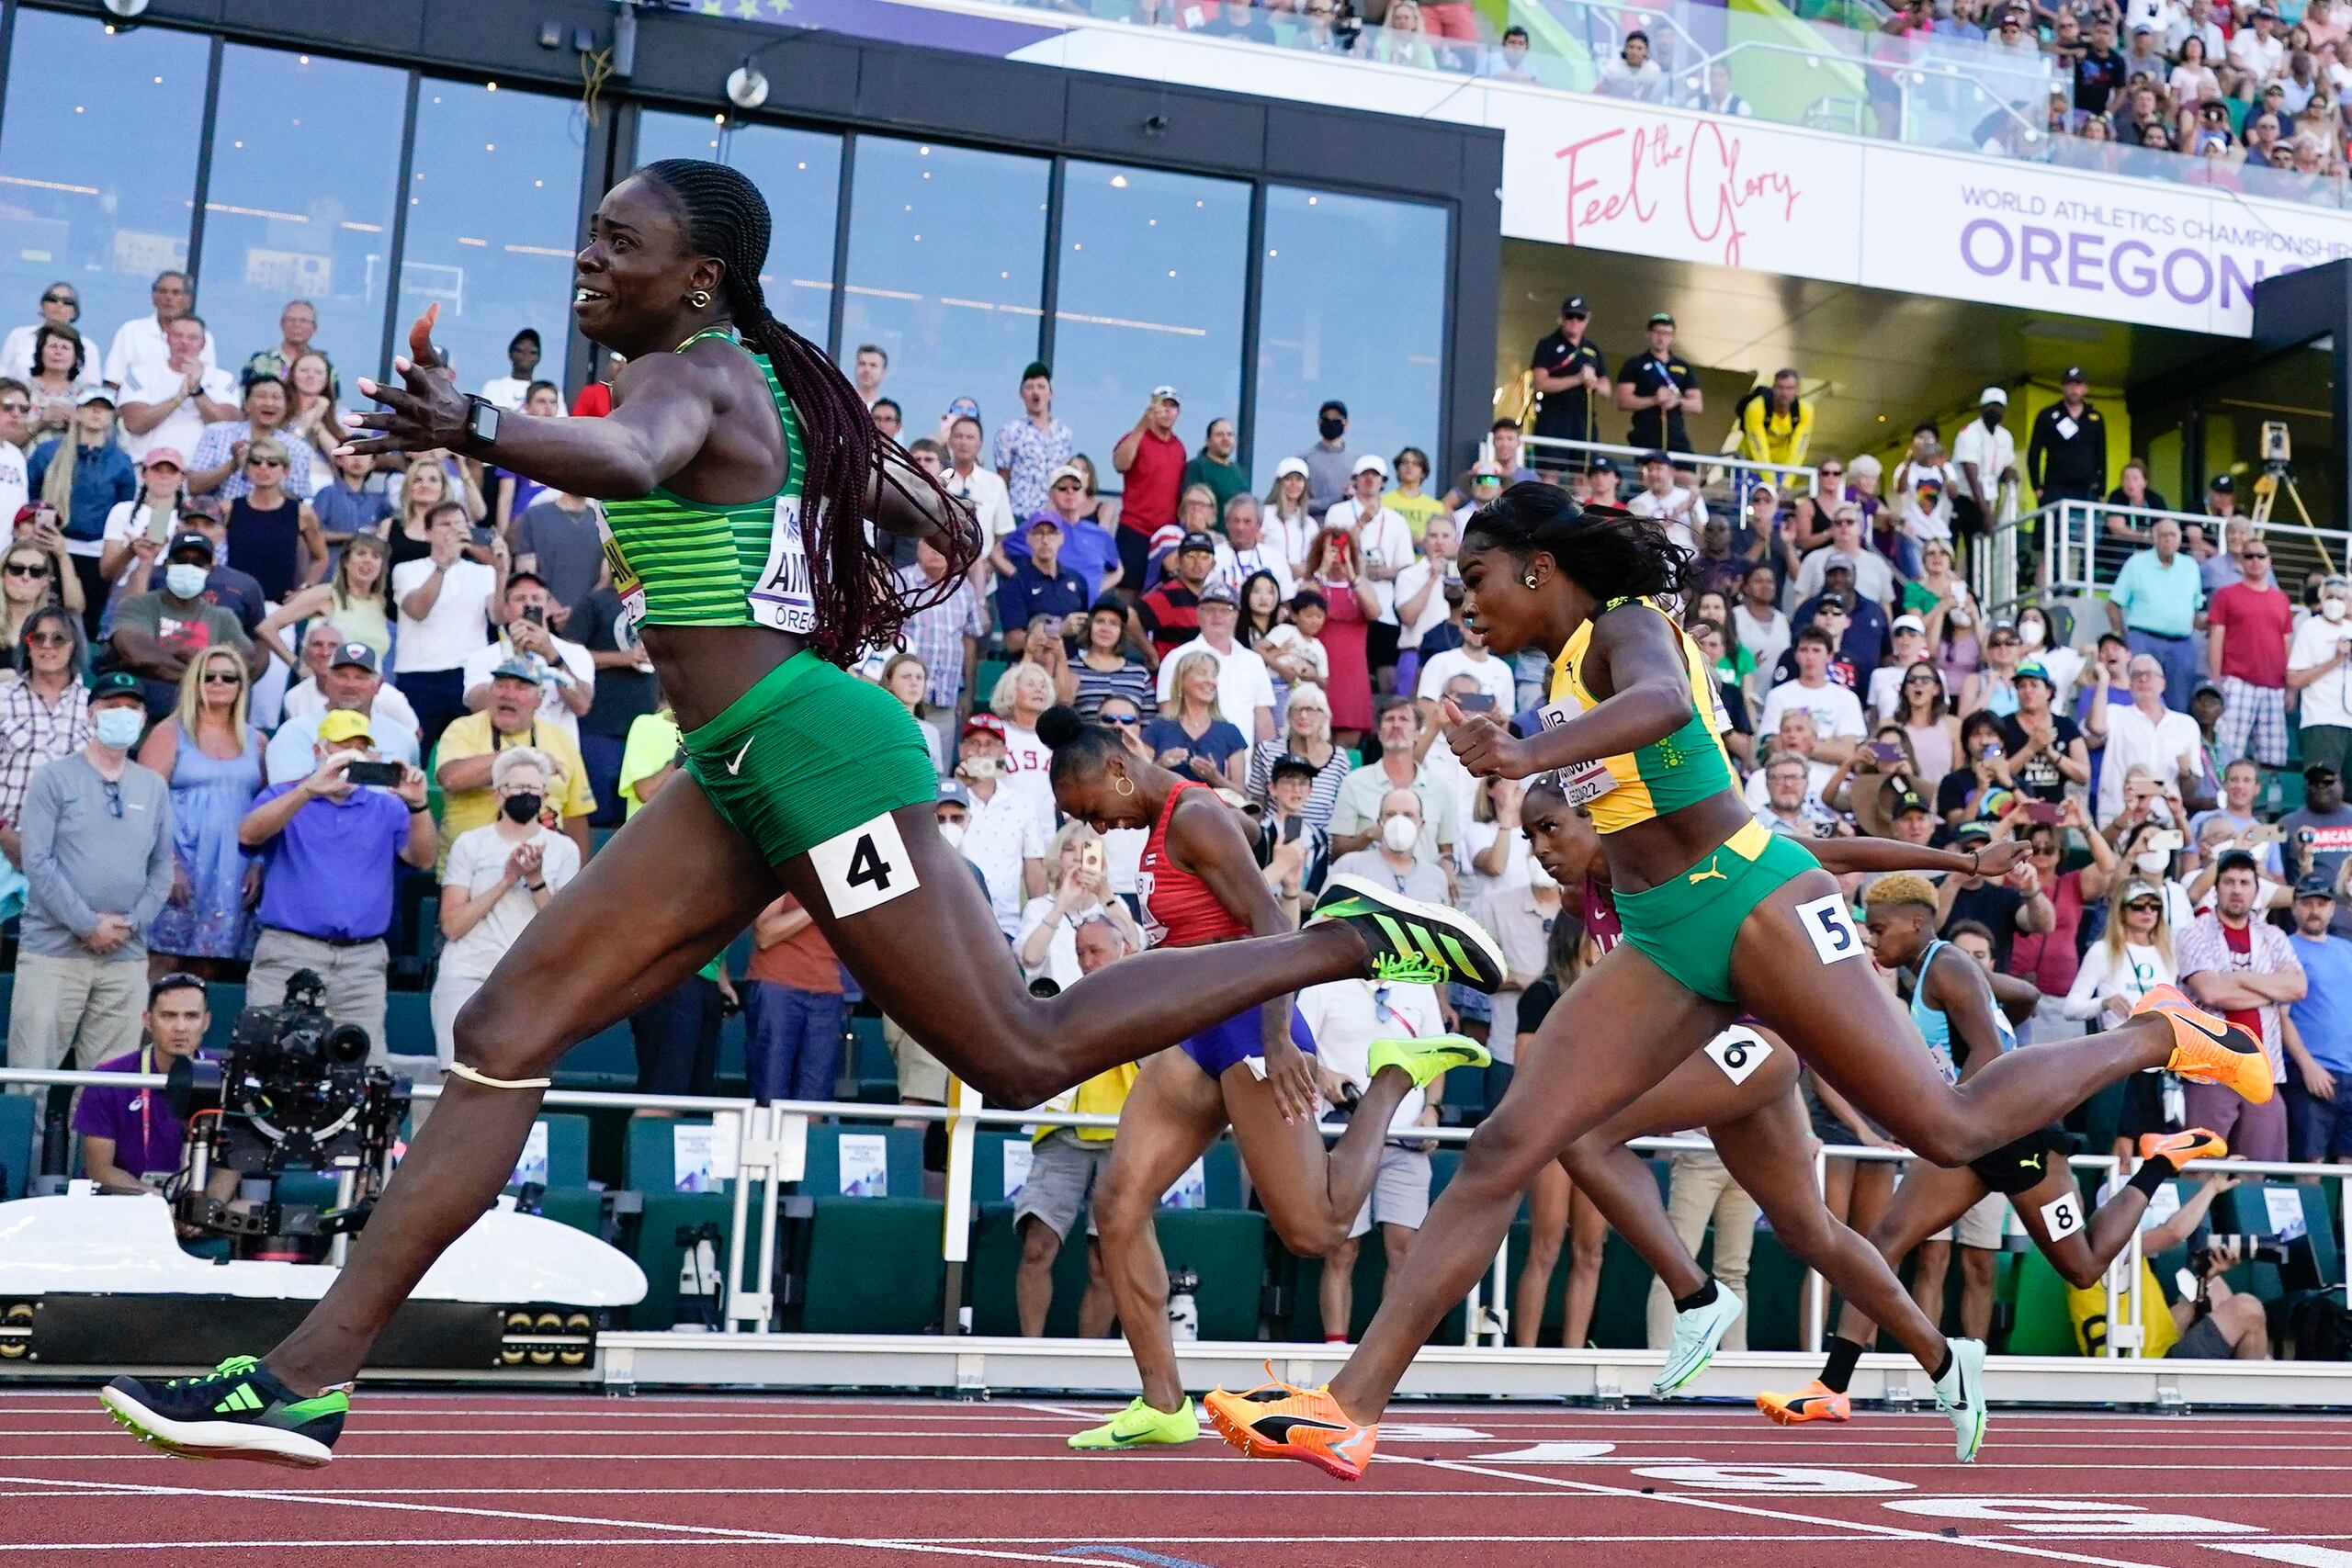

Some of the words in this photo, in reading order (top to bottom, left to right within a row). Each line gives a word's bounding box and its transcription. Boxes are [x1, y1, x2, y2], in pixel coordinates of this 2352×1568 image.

[1555, 128, 1657, 245] Feel
[1647, 123, 1683, 167] the
[1687, 120, 1801, 267] Glory
[1961, 185, 2046, 217] WORLD
[2053, 199, 2175, 236] ATHLETICS
[2182, 219, 2352, 259] CHAMPIONSHIP
[1961, 218, 2305, 310] OREGON
[846, 833, 892, 891] 4
[1816, 907, 1850, 950] 5
[1724, 1040, 1757, 1068] 6
[2055, 1204, 2073, 1229] 8
